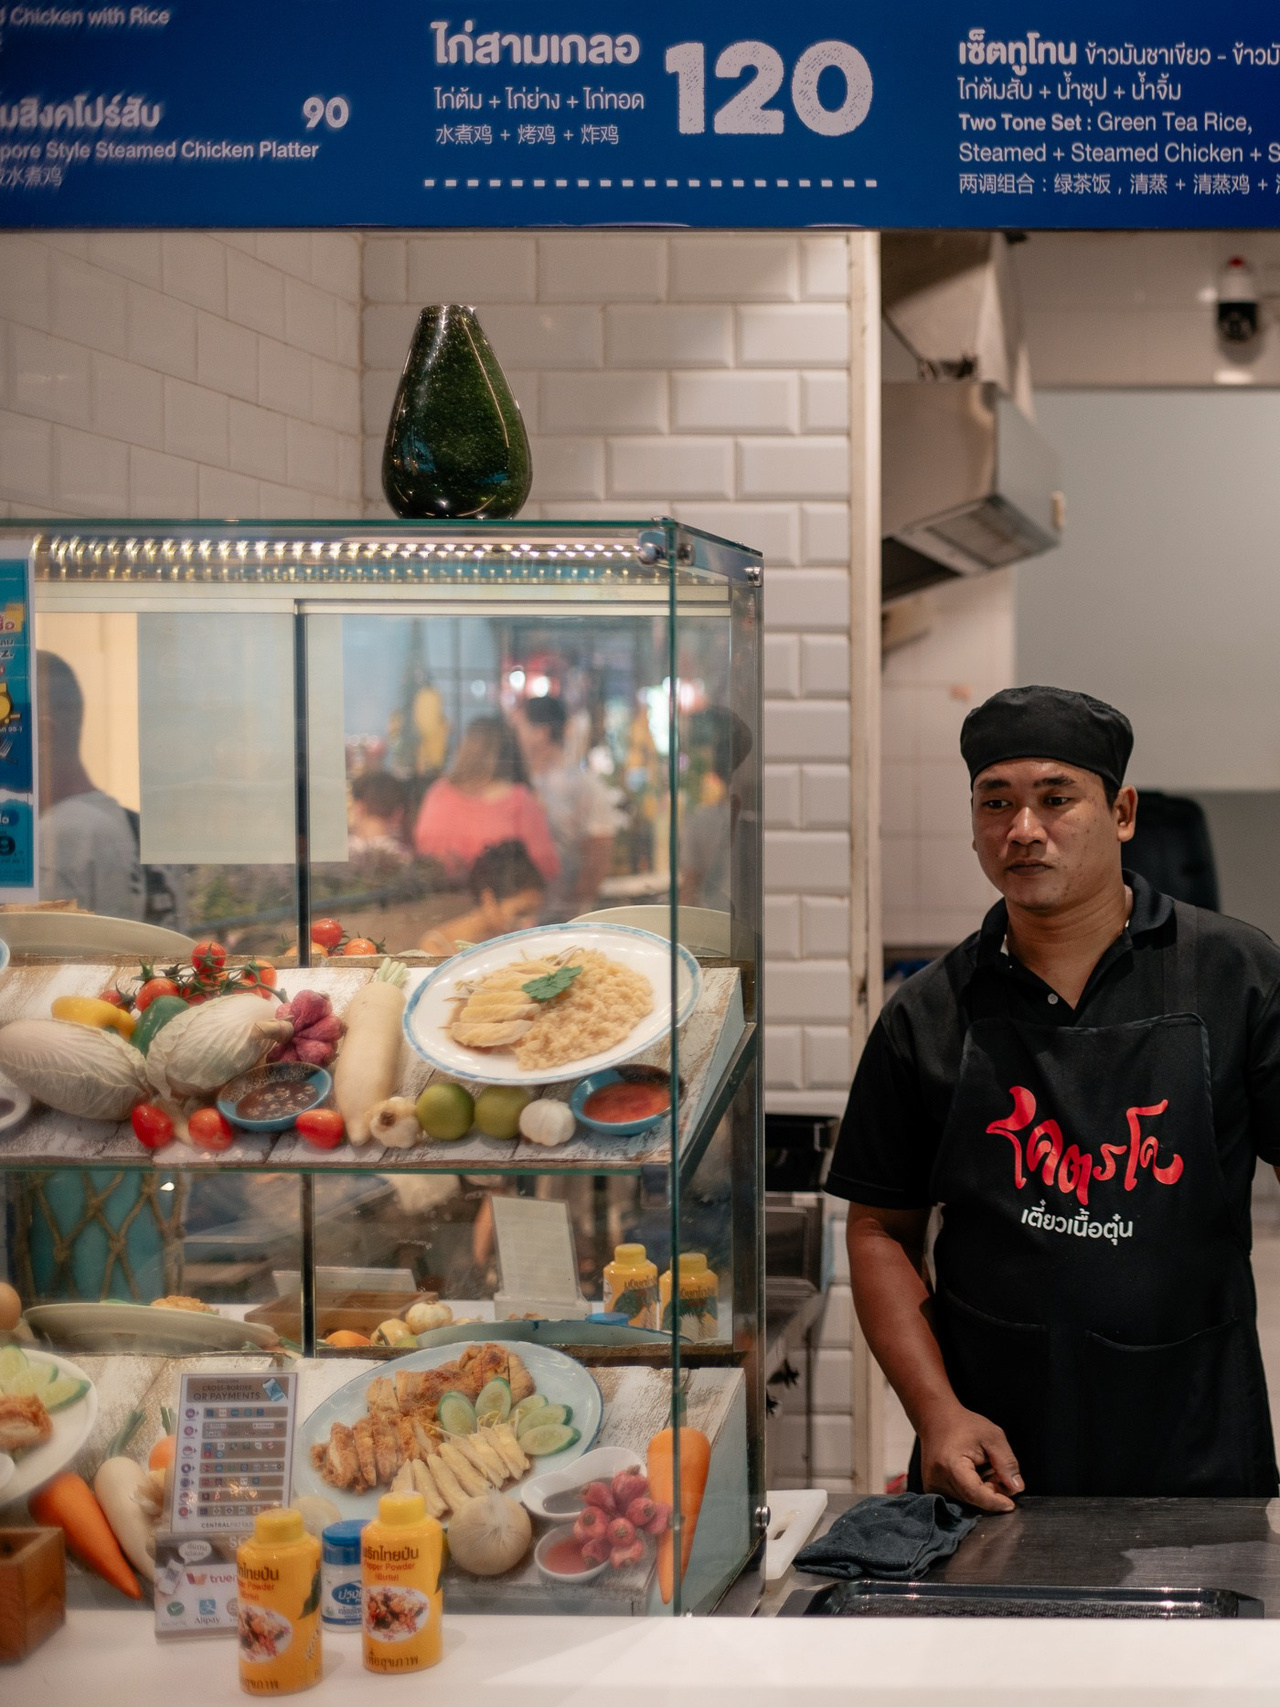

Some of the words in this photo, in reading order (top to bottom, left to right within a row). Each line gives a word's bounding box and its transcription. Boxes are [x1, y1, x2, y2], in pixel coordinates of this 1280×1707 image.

[10, 5, 83, 25] Chicken
[88, 6, 126, 25] with
[129, 6, 170, 25] Rice
[430, 20, 640, 65] ไก่สามเกลอ
[959, 28, 1077, 77] เซ็ตทูโทน
[1085, 41, 1211, 66] ข้าวมันชาเขียว
[434, 86, 483, 110] ไก่ต้ม
[505, 86, 561, 110] ไก่ย่าง
[583, 86, 645, 110] ไก่ทอด
[665, 40, 874, 137] 120
[957, 74, 1033, 101] ไก่ต้มสับ
[1057, 71, 1107, 107] น้ำซุป
[1132, 71, 1182, 101] น้ำจิ้ม
[303, 96, 349, 129] 90
[958, 113, 997, 132] Two
[1001, 113, 1047, 132] Tone
[1097, 111, 1157, 132] Green
[1162, 111, 1198, 132] Tea
[1204, 111, 1253, 135] Rice,
[435, 123, 493, 145] 水煮鸡
[517, 123, 556, 145] 烤鸡
[580, 123, 619, 145] 炸鸡
[46, 140, 91, 164] Style
[96, 141, 177, 159] Steamed
[181, 141, 255, 159] Chicken
[259, 141, 320, 159] Platter
[958, 142, 1047, 162] Steamed
[1071, 142, 1159, 162] Steamed
[1164, 142, 1244, 162] Chicken
[0, 165, 63, 187] 水煮鸡
[1193, 173, 1250, 195] 清蒸鸡
[193, 1392, 207, 1401] QR
[210, 1391, 261, 1400] PAYMENTS
